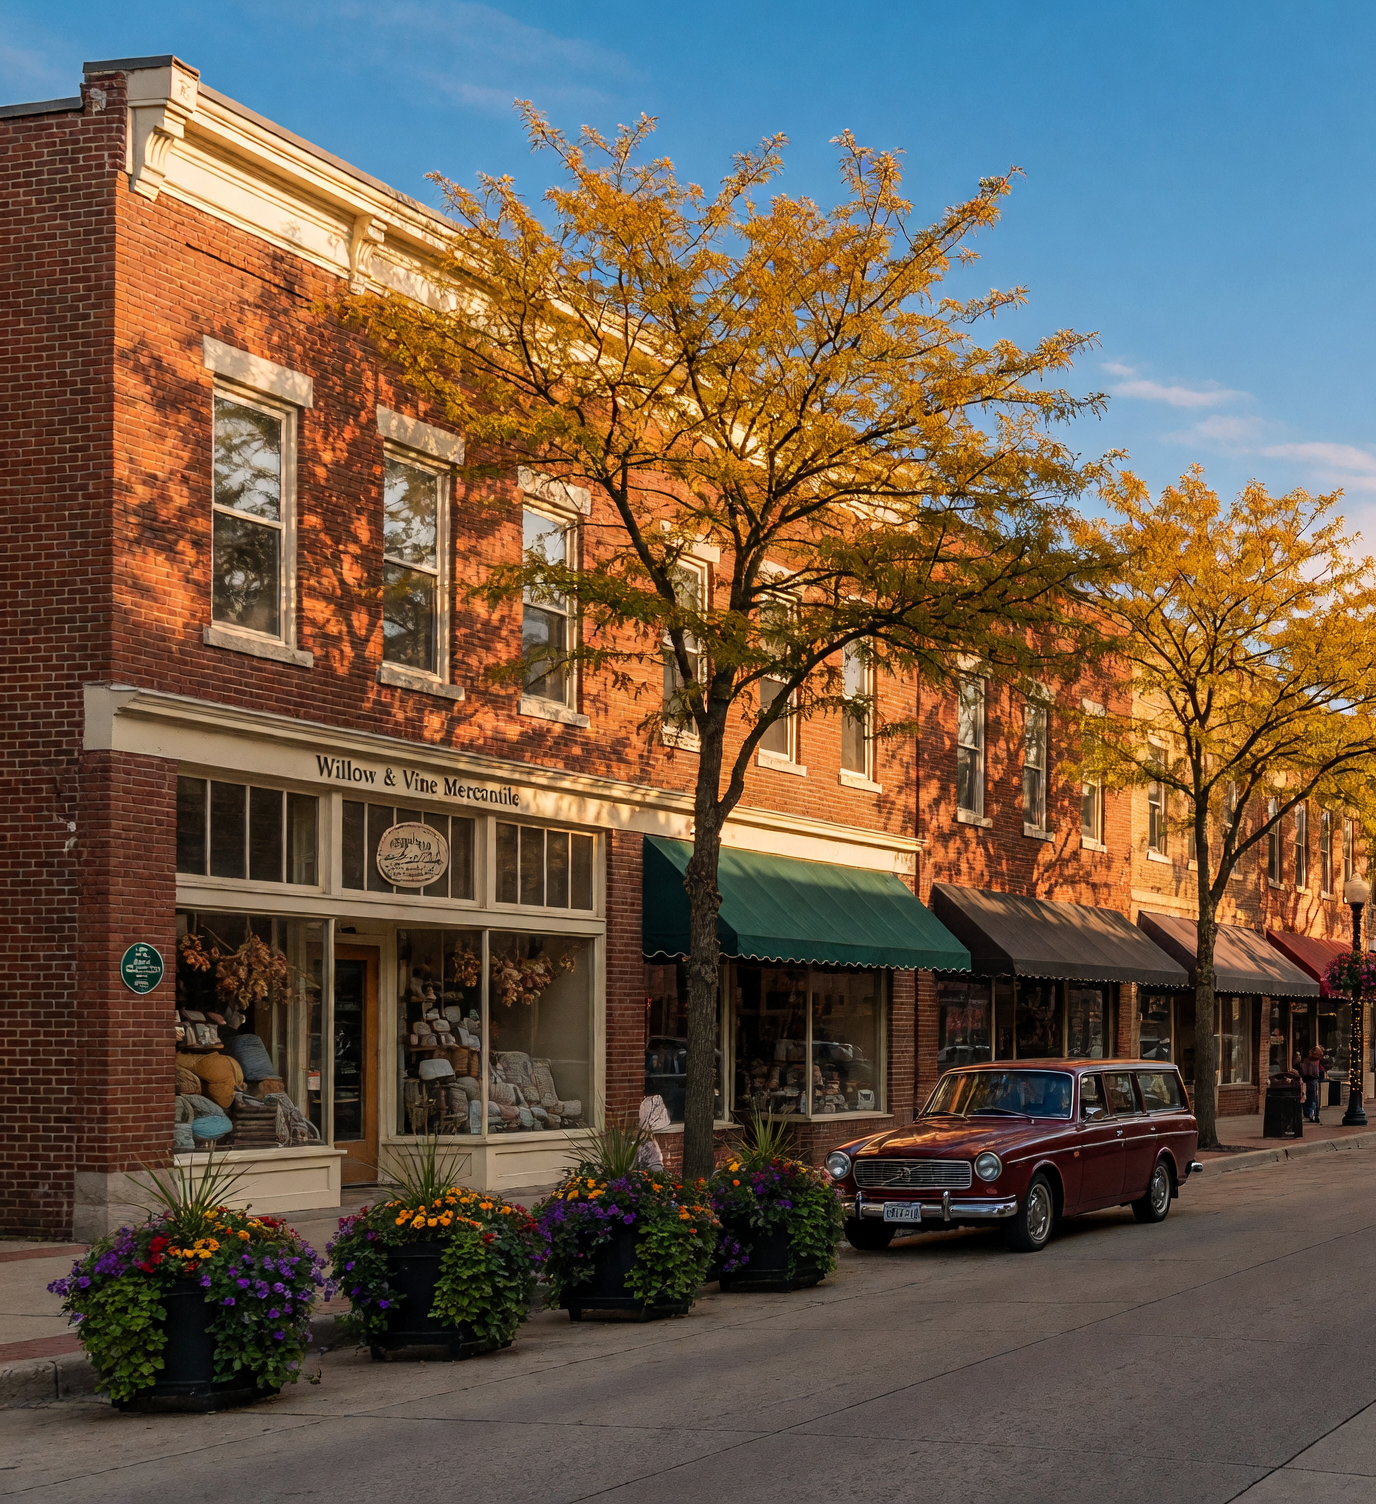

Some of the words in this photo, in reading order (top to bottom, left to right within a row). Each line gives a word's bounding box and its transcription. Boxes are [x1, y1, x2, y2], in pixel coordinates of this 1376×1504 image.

[316, 755, 377, 784] Willow
[383, 767, 396, 787] &
[403, 769, 438, 794] Vine
[444, 777, 520, 807] Mercantile
